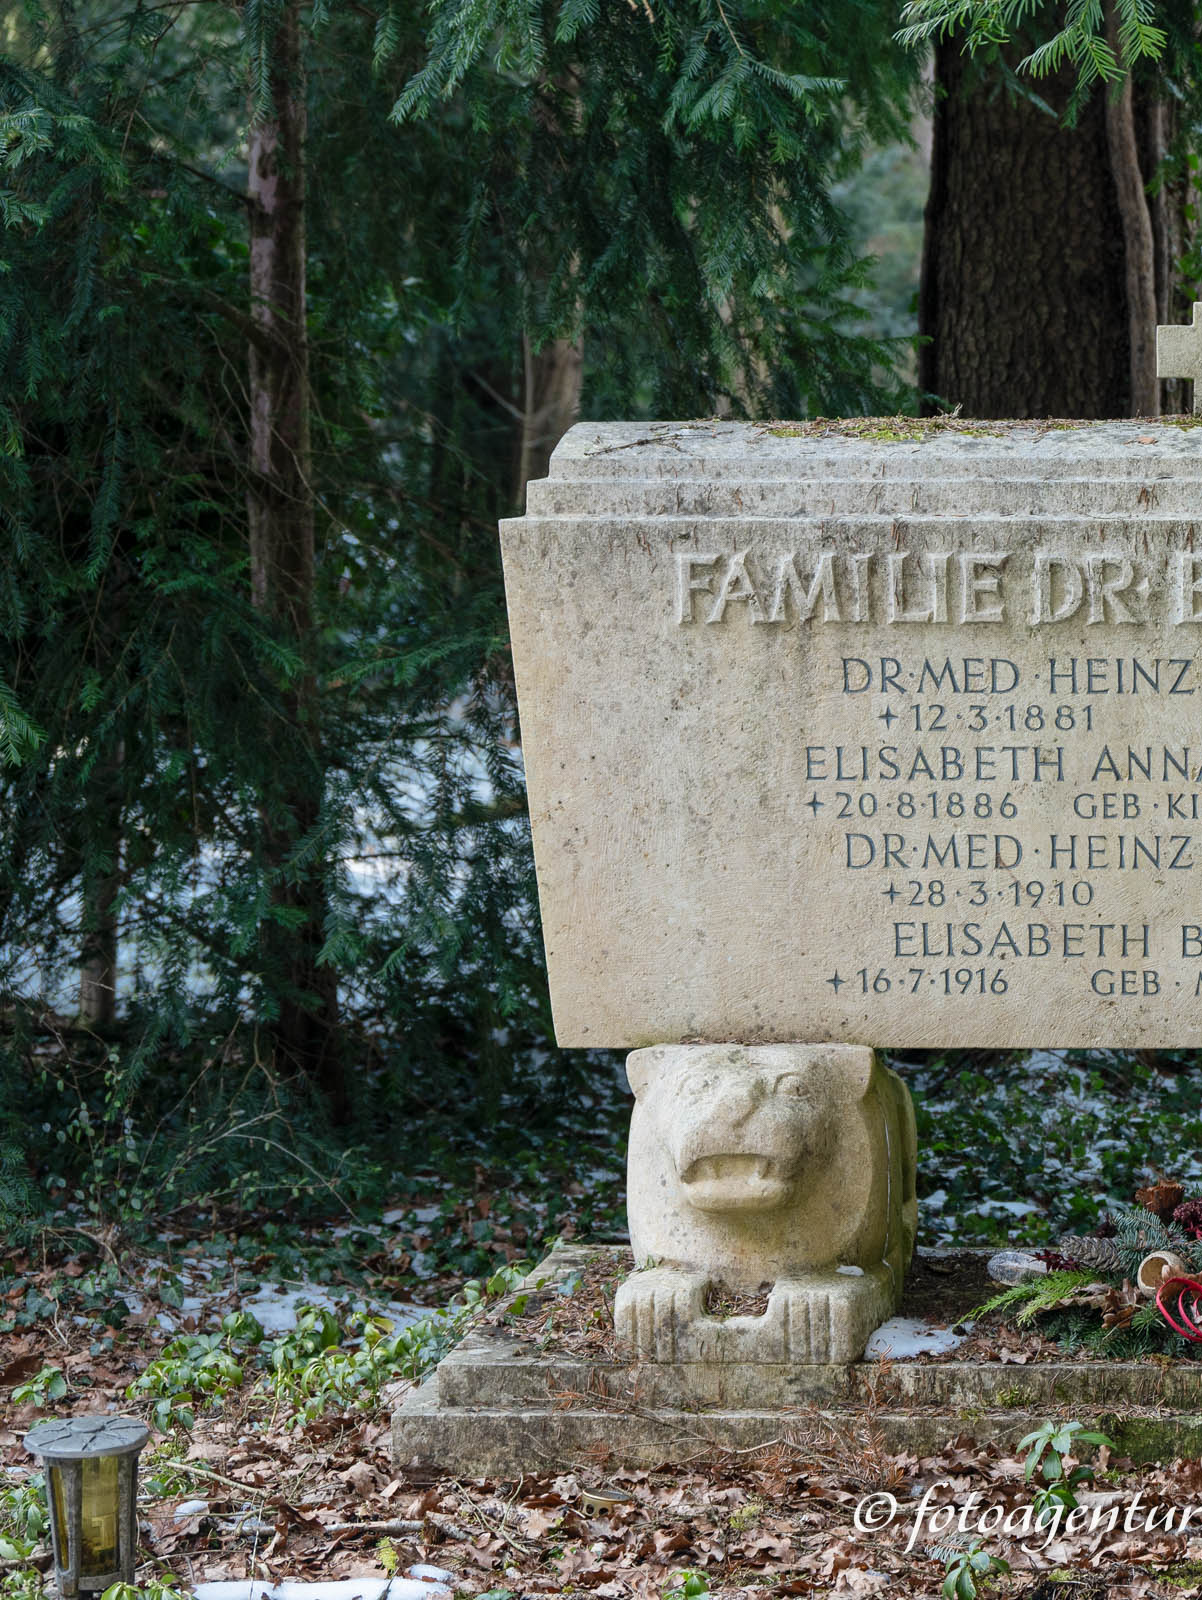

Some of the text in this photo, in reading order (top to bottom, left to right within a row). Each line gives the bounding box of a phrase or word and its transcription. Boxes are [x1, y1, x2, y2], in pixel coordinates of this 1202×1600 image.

[675, 550, 1005, 625] FAMILIE
[1048, 657, 1197, 696] HEINZ
[805, 745, 1065, 782] ELISABETH
[1049, 834, 1194, 870] HEINZ
[892, 921, 1151, 958] ELISABETH
